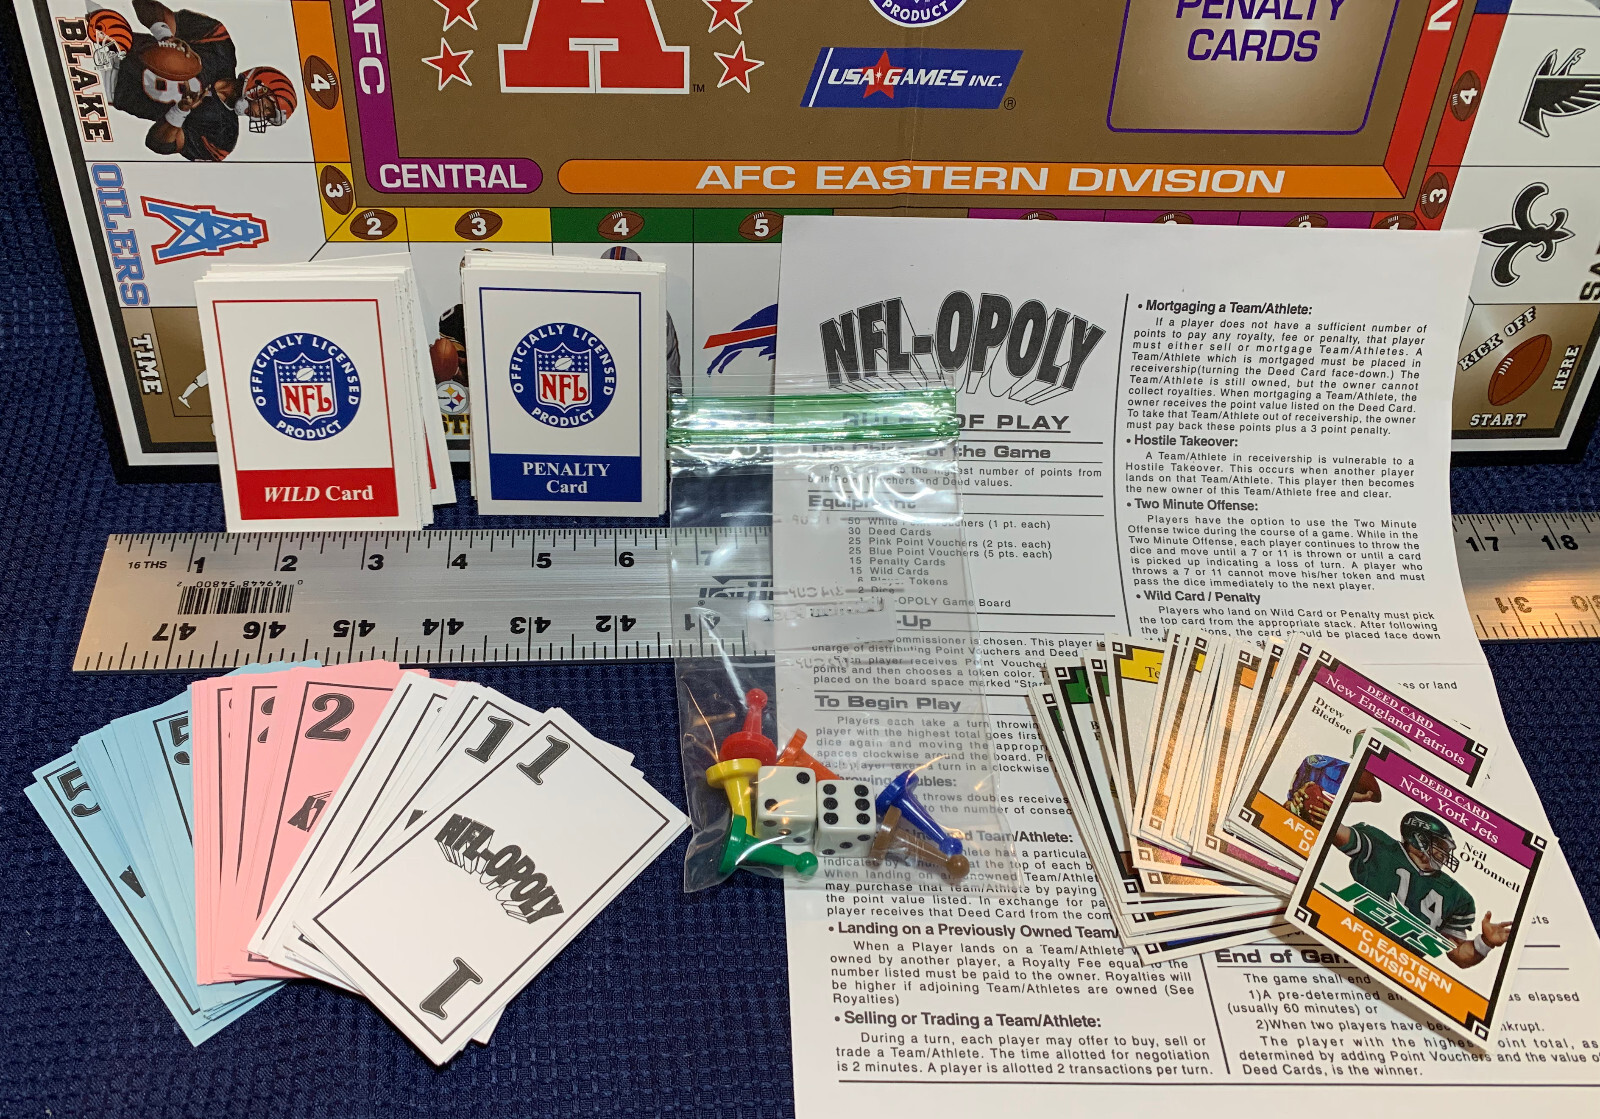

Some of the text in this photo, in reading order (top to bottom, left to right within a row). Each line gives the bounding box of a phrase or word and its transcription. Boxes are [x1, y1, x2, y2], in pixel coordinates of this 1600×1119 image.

[882, 0, 950, 22] PRODUCT
[1175, 0, 1346, 20] PENALTY
[1187, 28, 1321, 62] CARDS
[55, 17, 113, 142] BLAKE
[310, 73, 331, 92] 4
[883, 69, 968, 87] GAMES
[968, 74, 1003, 87] INC.
[1460, 88, 1478, 105] 4
[379, 163, 528, 189] CENTRAL
[695, 165, 1286, 194] AFC EASTERN DIVISION
[325, 182, 344, 199] 3
[1429, 188, 1448, 204] 3
[91, 163, 150, 306] OILERS
[366, 217, 383, 236] 2
[471, 217, 488, 236] 3
[613, 218, 630, 237] 4
[754, 218, 770, 237] 5
[1145, 299, 1312, 314] Mortgaging a Team/Athlete:
[819, 290, 1106, 396] NFL-OPOLY
[1458, 306, 1537, 371] KICK OFF
[131, 333, 163, 395] TIME
[511, 324, 616, 396] OFFICIALLY LICENSED
[1552, 345, 1583, 391] HERE
[251, 334, 361, 407] OFFICIALLY LICENSED
[540, 373, 588, 405] NFL
[282, 384, 332, 416] NFL
[531, 406, 595, 427] PRODUCT
[996, 414, 1070, 430] PLAY
[1470, 413, 1528, 427] START
[276, 420, 342, 439] PRODUCT
[1126, 421, 1151, 430] must
[1155, 422, 1174, 431] pay
[1178, 421, 1202, 429] back
[1206, 422, 1235, 430] these
[1239, 422, 1270, 432] points
[1275, 423, 1296, 433] plus
[1310, 424, 1316, 432] 3
[1320, 424, 1346, 434] point
[1350, 426, 1390, 436] penalty.
[1134, 434, 1237, 446] Hostile Takeover:
[993, 445, 1052, 459] Game
[522, 461, 611, 477] PENALTY
[263, 485, 374, 503] WILD Card
[546, 480, 588, 494] Card
[1134, 497, 1258, 510] Two Minute Offense:
[848, 526, 931, 536] 30 Deed Cards
[848, 536, 1050, 550] 25 Pink Point Vouchers (2 pts. each)
[848, 546, 1052, 559] 25 Blue Point Vouchers (5 pts. each)
[128, 560, 168, 569] 16 THS
[193, 551, 635, 573] 1 2 3 4 5 6
[849, 556, 945, 567] 15 Penalty Cards
[849, 566, 928, 575] 15 Wild Cards
[1143, 590, 1260, 604] Wild Card / Penalty
[814, 695, 961, 713] To Begin Play
[1315, 696, 1345, 719] Drew
[1366, 685, 1434, 730] DEED CARD
[305, 692, 355, 742] 2
[1311, 705, 1352, 735] Bledsoe
[1325, 674, 1466, 766] New England Patriots
[465, 715, 514, 764] 1
[516, 734, 571, 786] 1
[57, 766, 101, 817] 5
[1419, 773, 1491, 821] DEED CARD
[1399, 776, 1499, 844] New York Jets
[1283, 817, 1315, 841] AFC
[1403, 816, 1432, 830] JETS
[1463, 841, 1488, 862] Neil
[434, 813, 565, 924] NFL-OPOLY
[1459, 851, 1521, 893] O'Donnell
[1319, 881, 1457, 958] JETS
[838, 921, 1072, 939] Landing on a Previously Owned
[1215, 949, 1293, 963] End of
[1341, 916, 1453, 994] AFC EASTERN
[1357, 941, 1427, 993] DIVISION
[420, 957, 483, 1020] 1
[844, 1010, 1101, 1029] Selling or Trading a Team/Athlete:
[1242, 1063, 1422, 1075] Deed Cards, is the winner.
